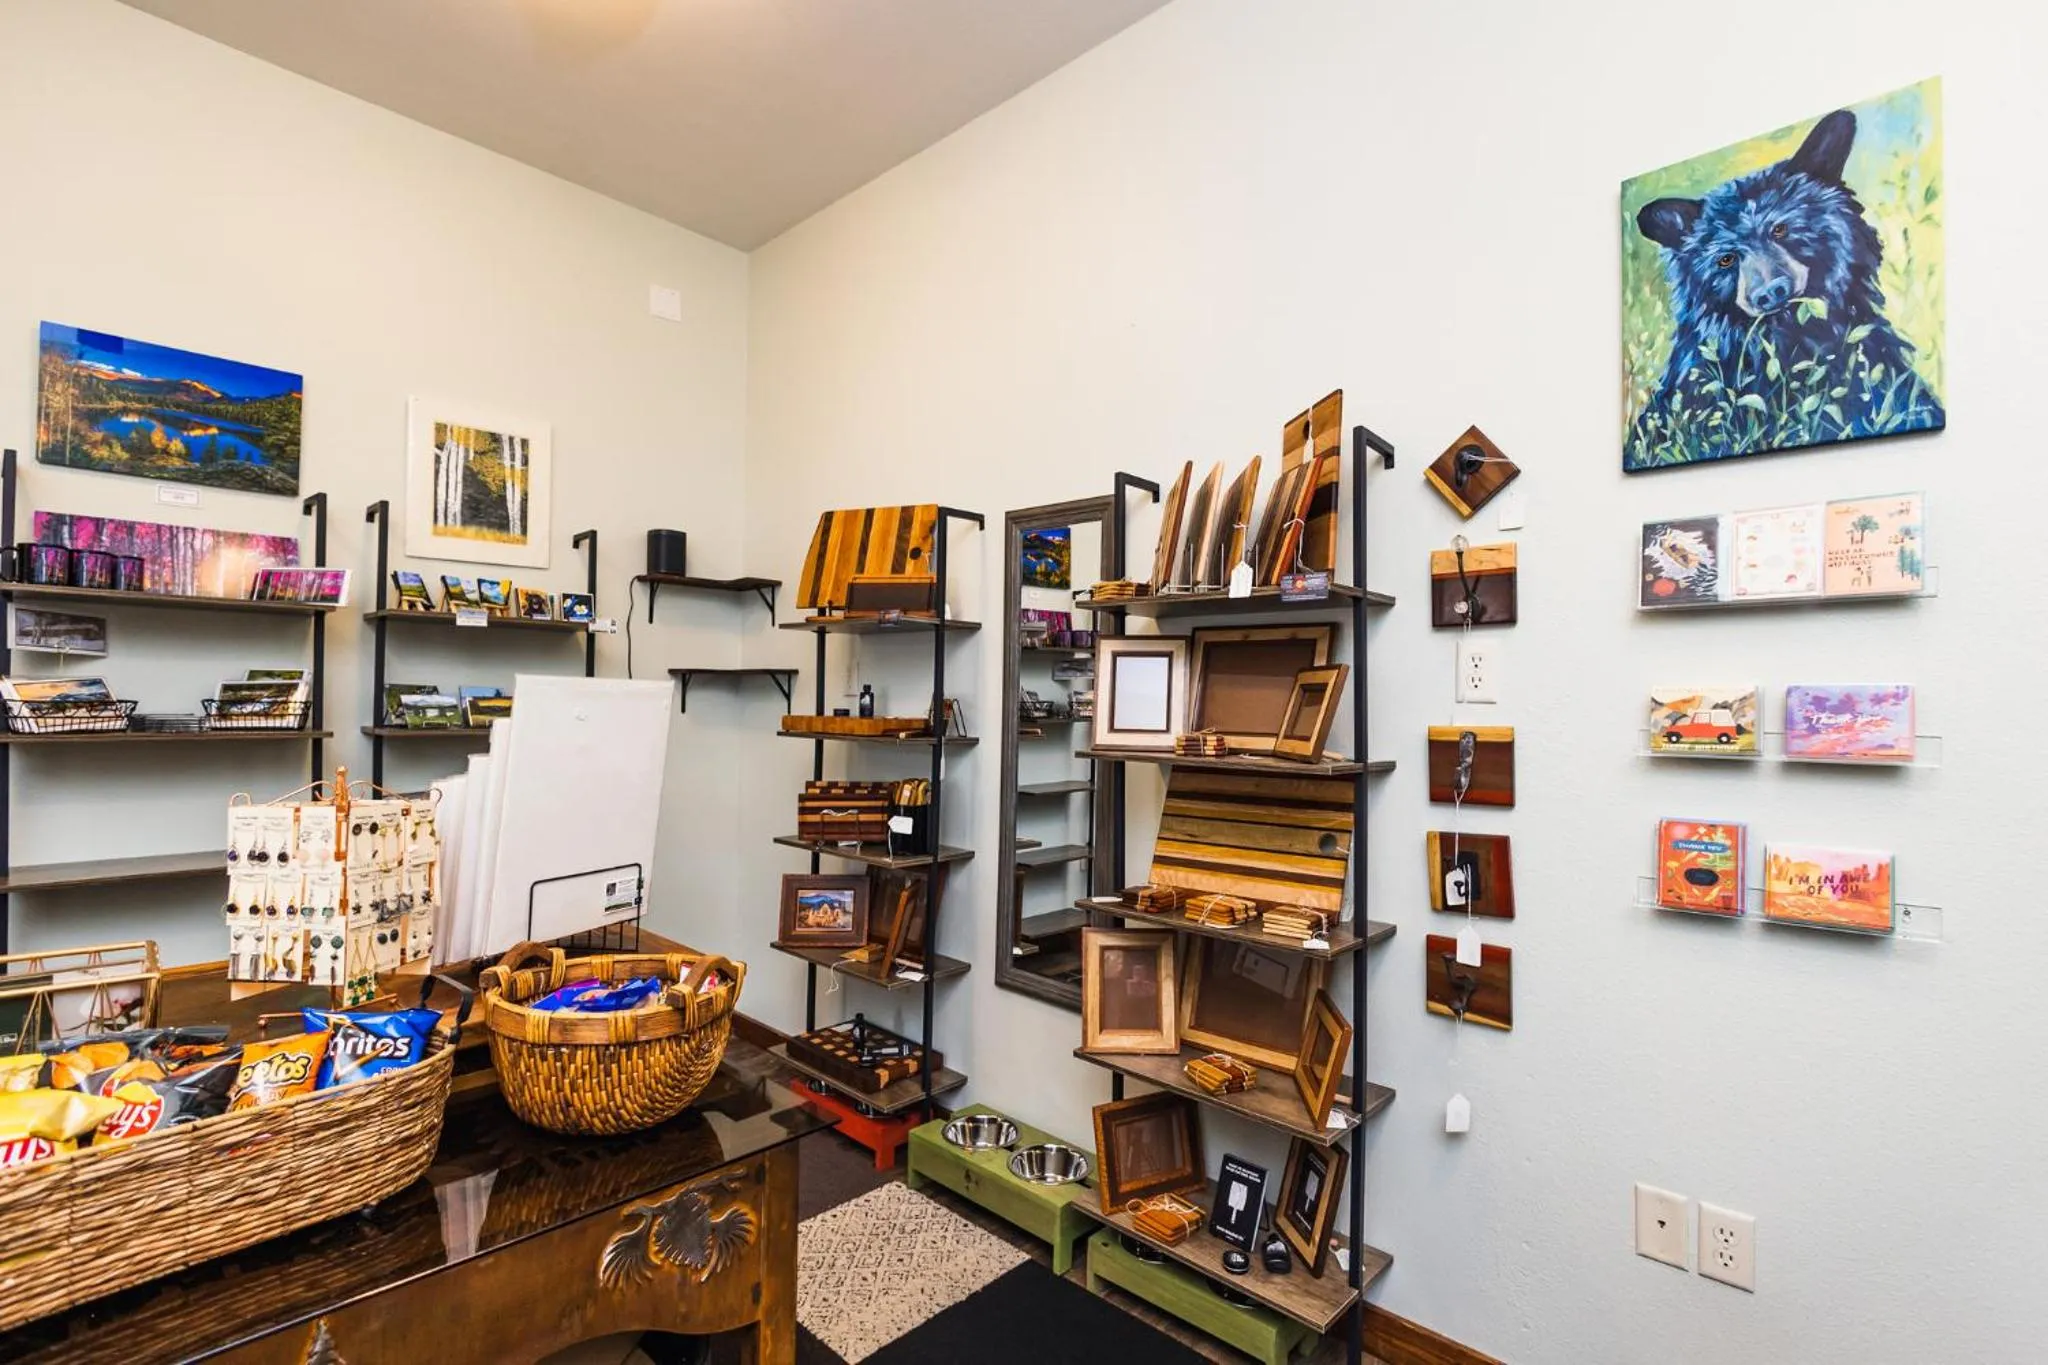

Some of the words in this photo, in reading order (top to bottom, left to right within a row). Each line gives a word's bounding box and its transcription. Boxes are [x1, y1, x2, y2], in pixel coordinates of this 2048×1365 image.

[1788, 875, 1810, 885] I'M
[1816, 874, 1835, 884] IN
[1839, 872, 1869, 884] AWE
[1806, 885, 1823, 895] OF
[1831, 884, 1859, 895] YOU
[329, 1032, 412, 1057] oritos
[239, 1055, 310, 1088] eetos
